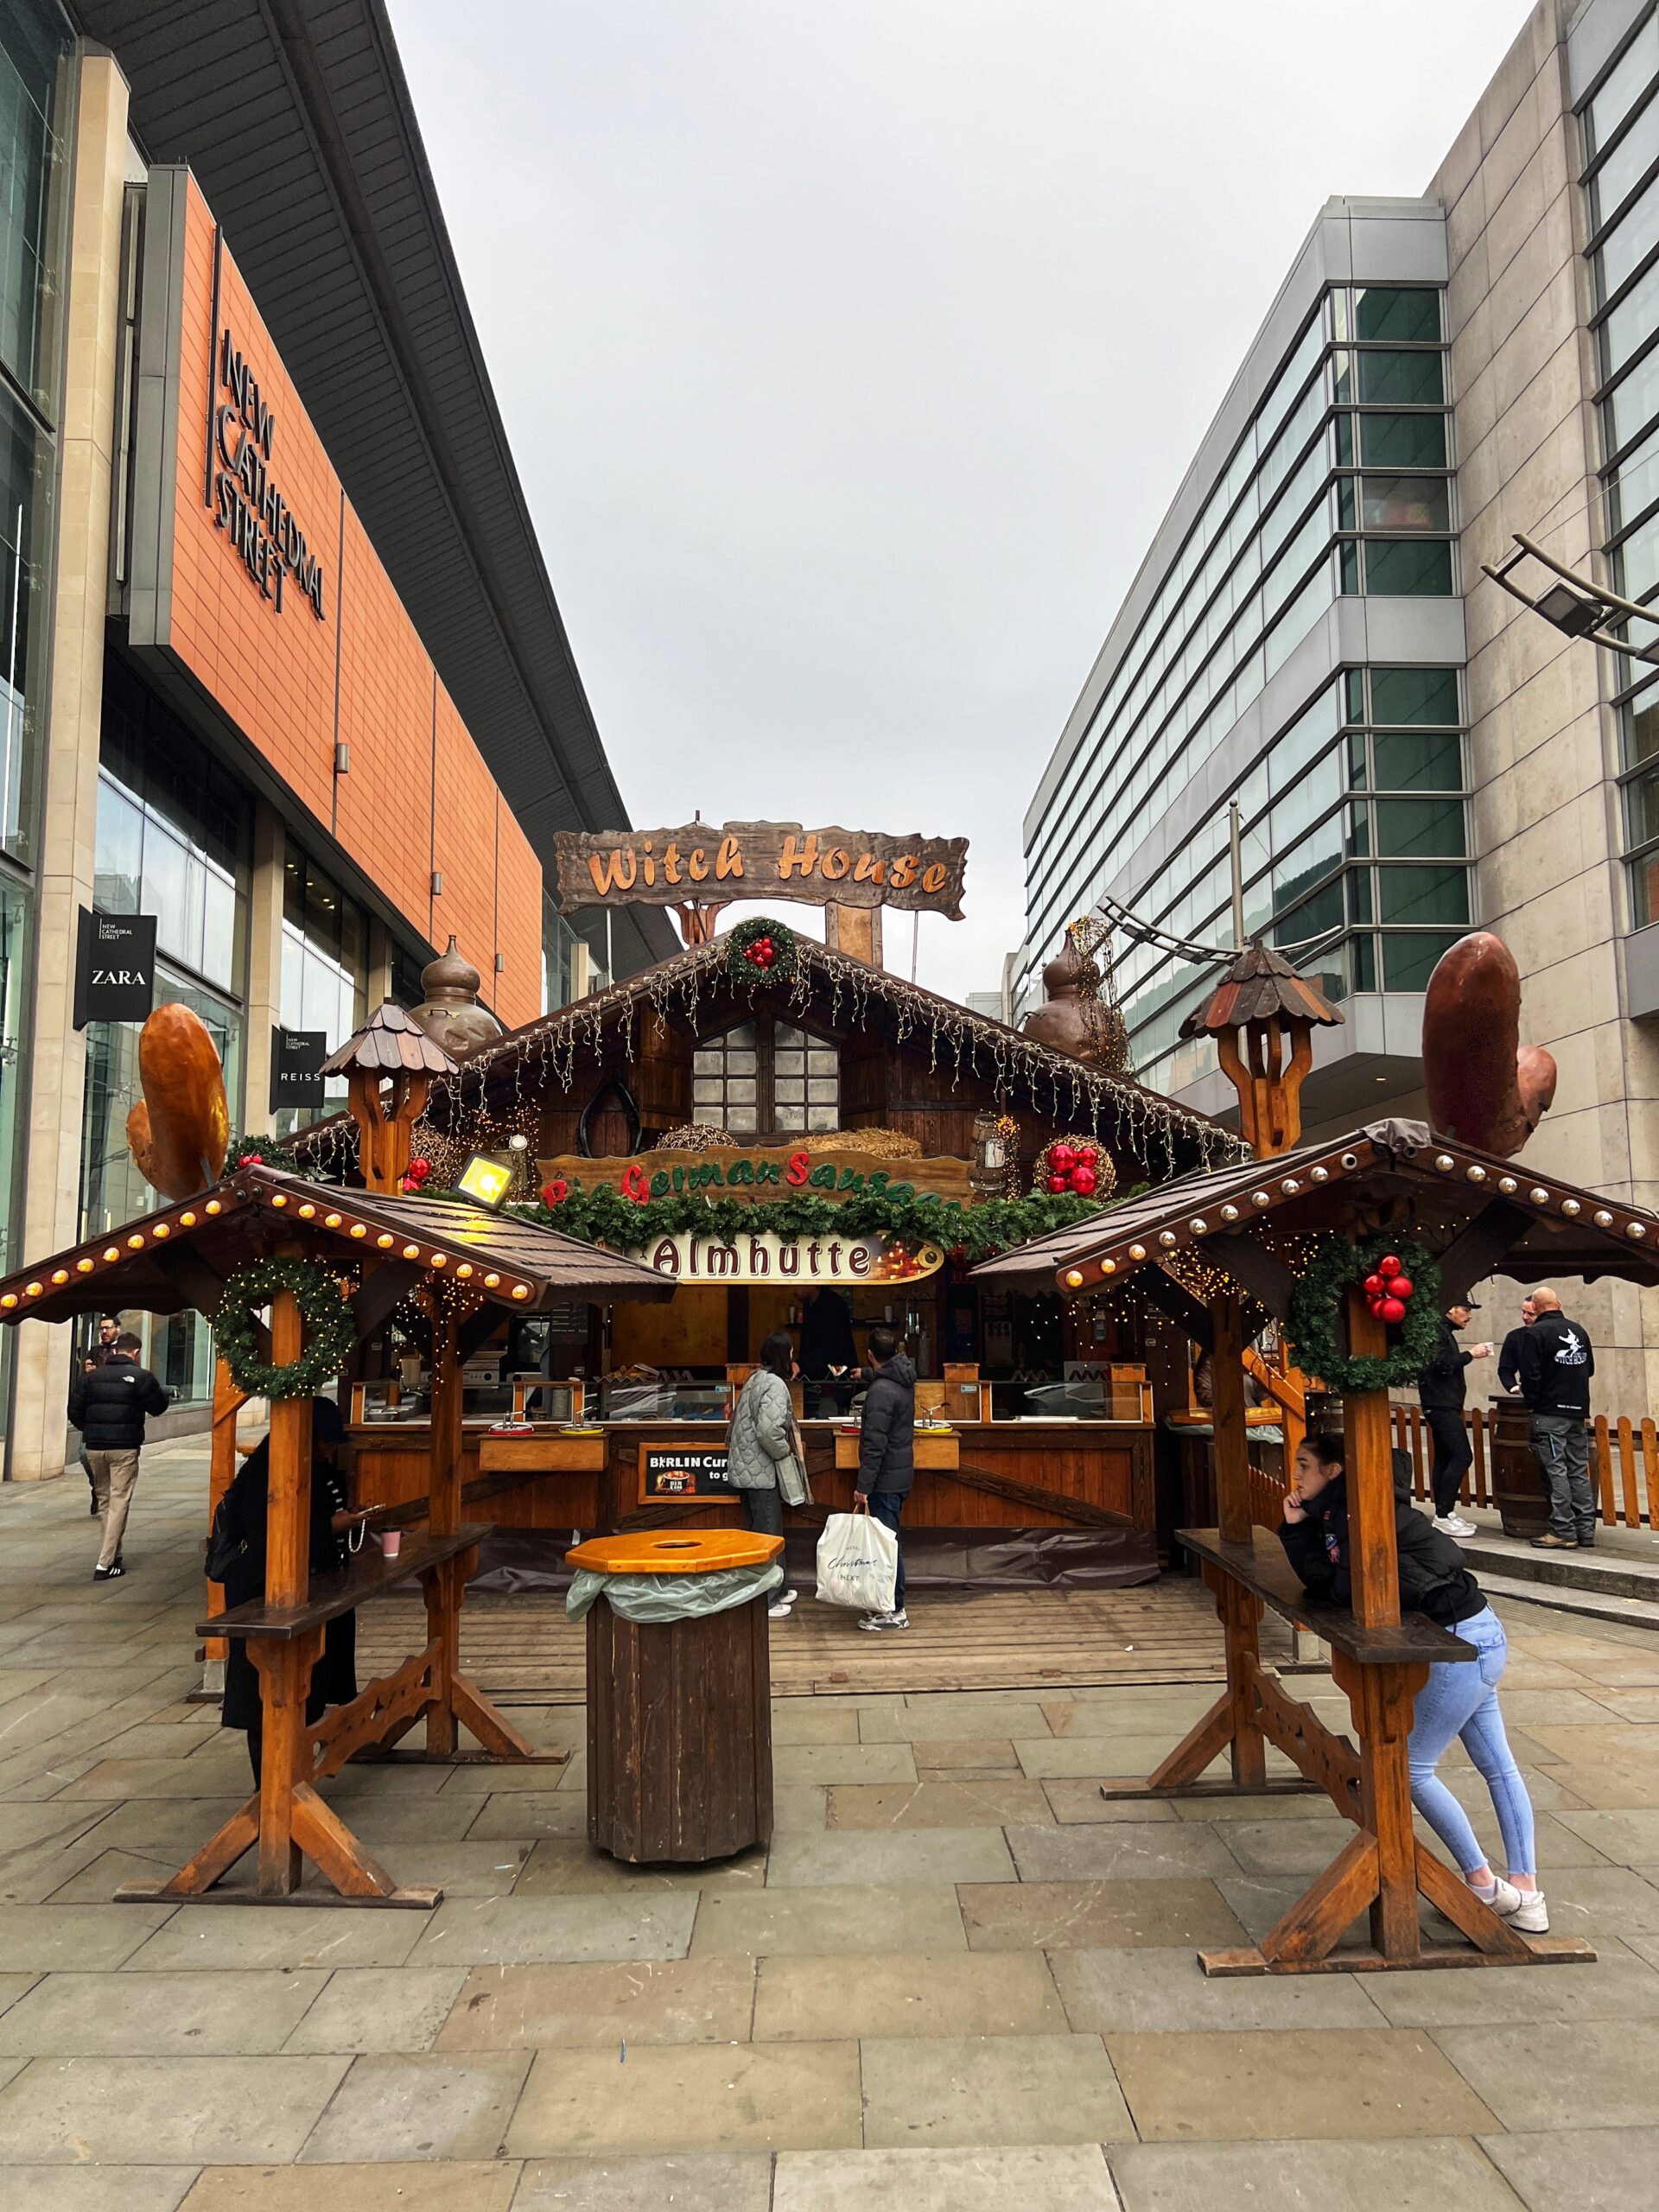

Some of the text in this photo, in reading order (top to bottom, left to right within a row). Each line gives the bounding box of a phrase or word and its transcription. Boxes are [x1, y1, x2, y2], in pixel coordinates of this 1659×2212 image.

[222, 329, 275, 461] NEW
[218, 404, 325, 620] CATHEDRAL
[215, 472, 288, 613] STREET
[588, 833, 948, 896] Witch House
[92, 970, 146, 985] ZARA
[281, 1072, 321, 1081] REISS
[621, 1159, 779, 1206] German
[652, 1237, 871, 1276] Almhütte
[702, 1456, 729, 1468] Cur
[709, 1471, 721, 1479] to
[840, 1573, 860, 1582] NEXT
